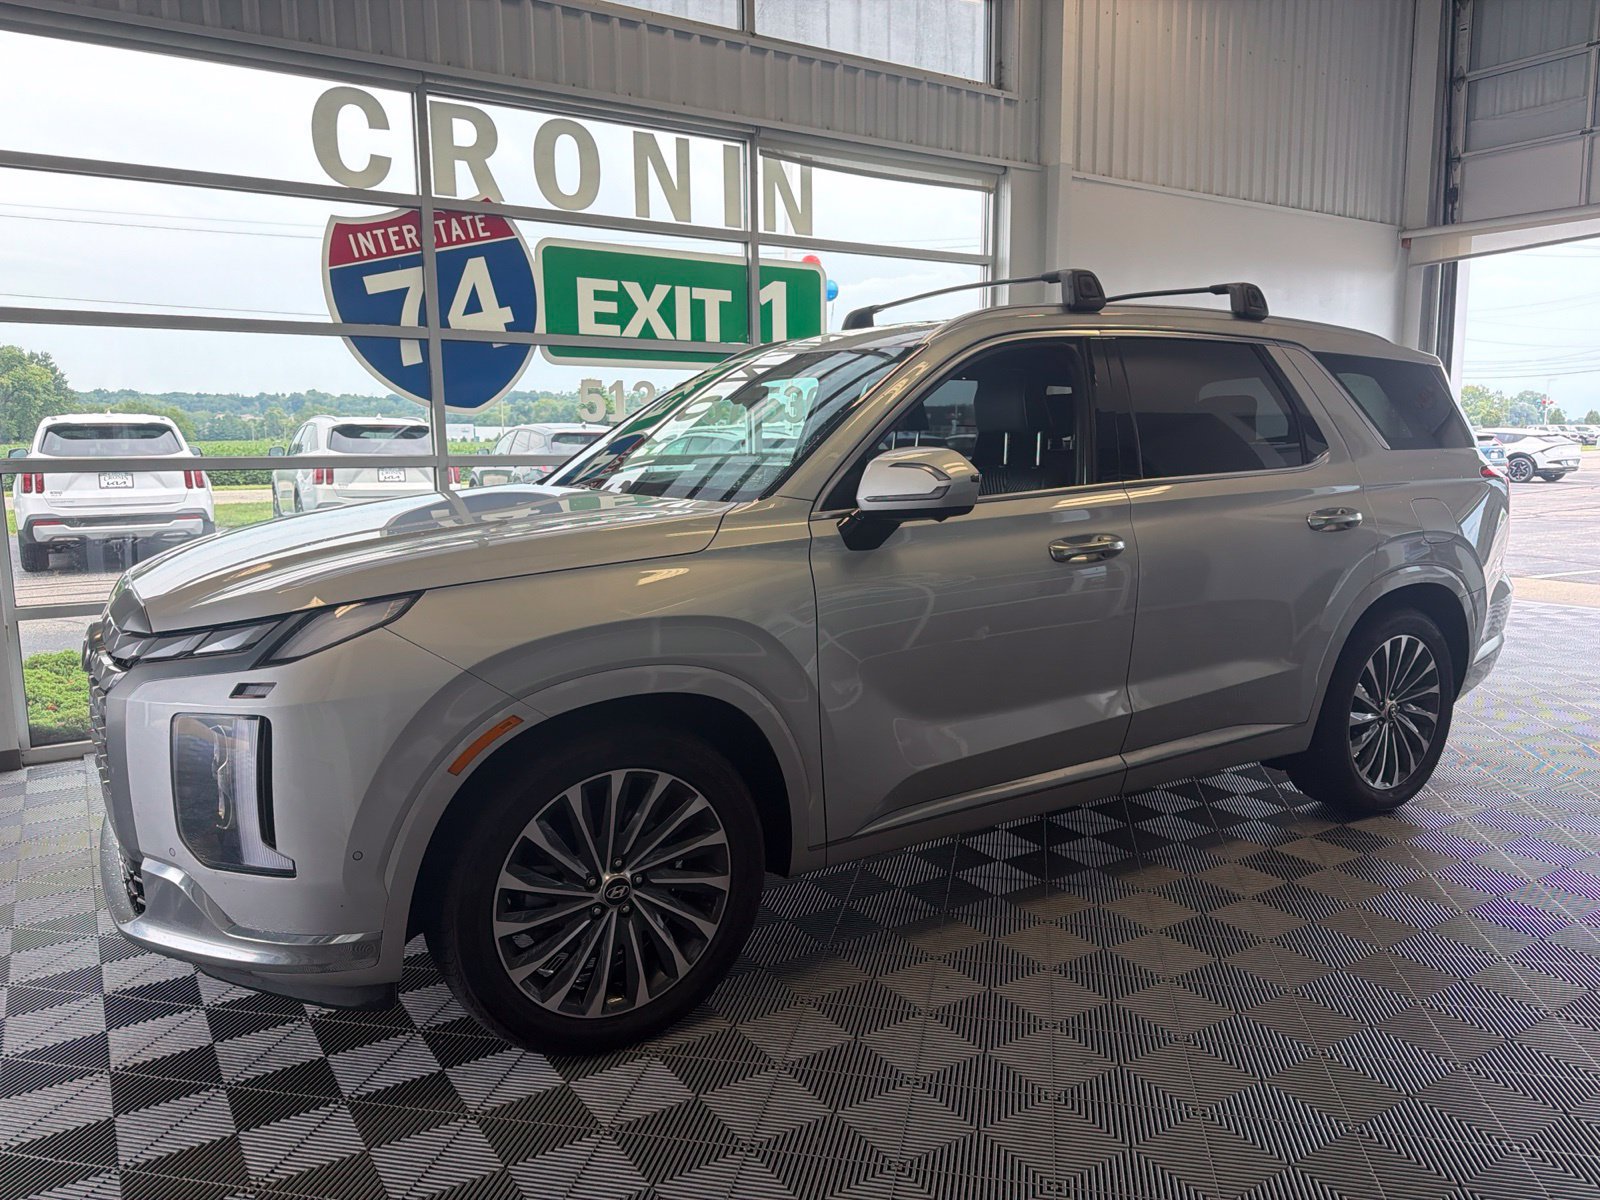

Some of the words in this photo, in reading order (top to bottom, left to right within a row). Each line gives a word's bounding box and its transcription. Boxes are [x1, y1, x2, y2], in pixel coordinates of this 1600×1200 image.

[311, 86, 812, 237] CRONIN
[348, 214, 491, 258] INTERTATE
[362, 256, 515, 367] 74
[576, 277, 732, 343] EXIT
[759, 280, 788, 343] 1
